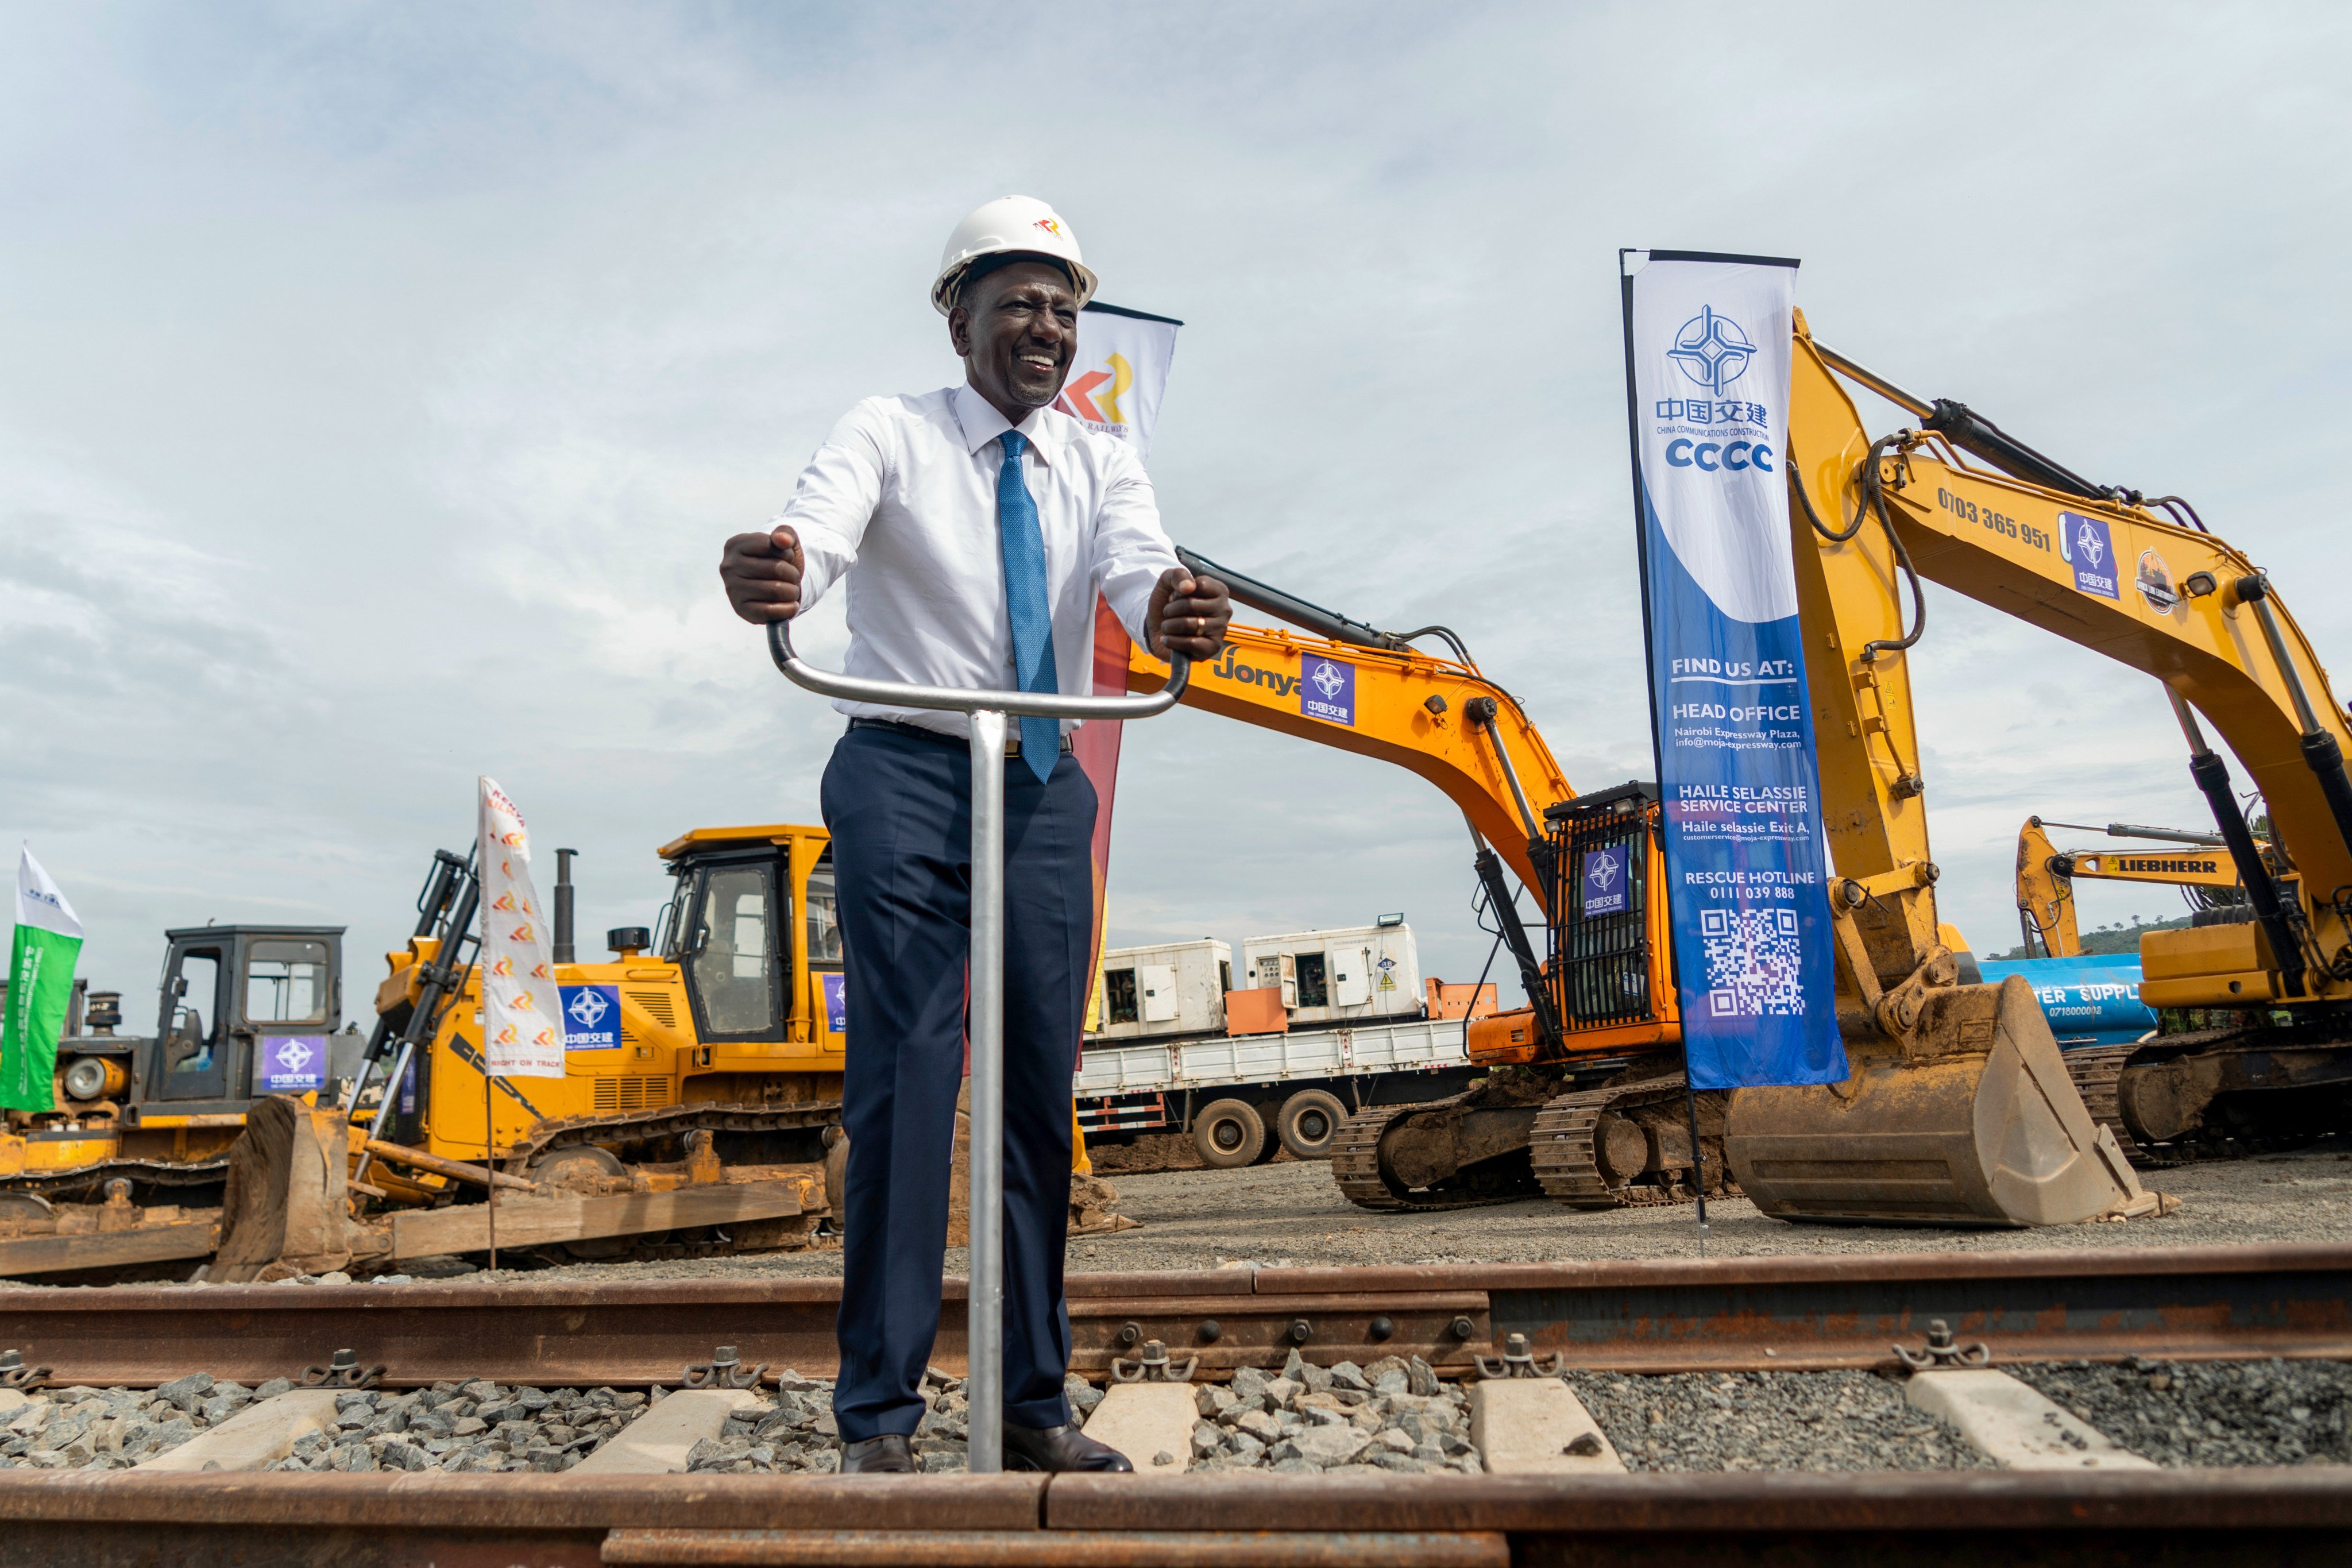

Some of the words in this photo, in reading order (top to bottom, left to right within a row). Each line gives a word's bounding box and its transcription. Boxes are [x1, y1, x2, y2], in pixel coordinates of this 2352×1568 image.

[1656, 397, 1768, 429] 中国交建
[1657, 426, 1676, 434] CHINA
[1677, 426, 1728, 438] COMMUNICATIONS
[1729, 428, 1769, 442] CONSTRUCTION
[1666, 438, 1773, 472] CCCC
[1937, 487, 1978, 523] 0703
[1983, 508, 2017, 539] 365
[2022, 523, 2051, 553] 951
[2079, 571, 2113, 590] 中国交建
[1673, 658, 1721, 674] FIND
[1725, 662, 1751, 677] US
[1758, 660, 1793, 676] AT:
[1308, 700, 1347, 719] 中国交建
[1673, 704, 1725, 719] HEAD
[1729, 705, 1800, 721] OFFICE
[1675, 727, 1712, 736] Nairobi
[1715, 727, 1766, 740] Expressway
[1770, 730, 1800, 739] Plaza,
[1676, 737, 1801, 751] info@moja-expressway.com
[1679, 785, 1729, 798] HAILE
[1732, 786, 1806, 800] SELASSIE
[1681, 800, 1741, 813] SERVICE
[1744, 801, 1808, 813] CENTER
[1682, 821, 1717, 832] Haile
[1721, 821, 1766, 833] selassie
[1770, 821, 1794, 833] Exit
[1797, 822, 1809, 835] A,
[1683, 834, 1809, 843] customerservice@moja-expressway.com
[2119, 859, 2217, 873] LIEBHERR
[1686, 871, 1745, 884] RESCUE
[1749, 872, 1815, 884] HOTLINE
[1710, 887, 1740, 899] 0111
[1745, 887, 1770, 898] 039
[1775, 887, 1795, 899] 888
[1586, 894, 1622, 909] 中国交建
[2079, 986, 2139, 1002] SUPPL
[2049, 1006, 2102, 1017] 0718000002
[565, 1032, 613, 1044] 中国交建
